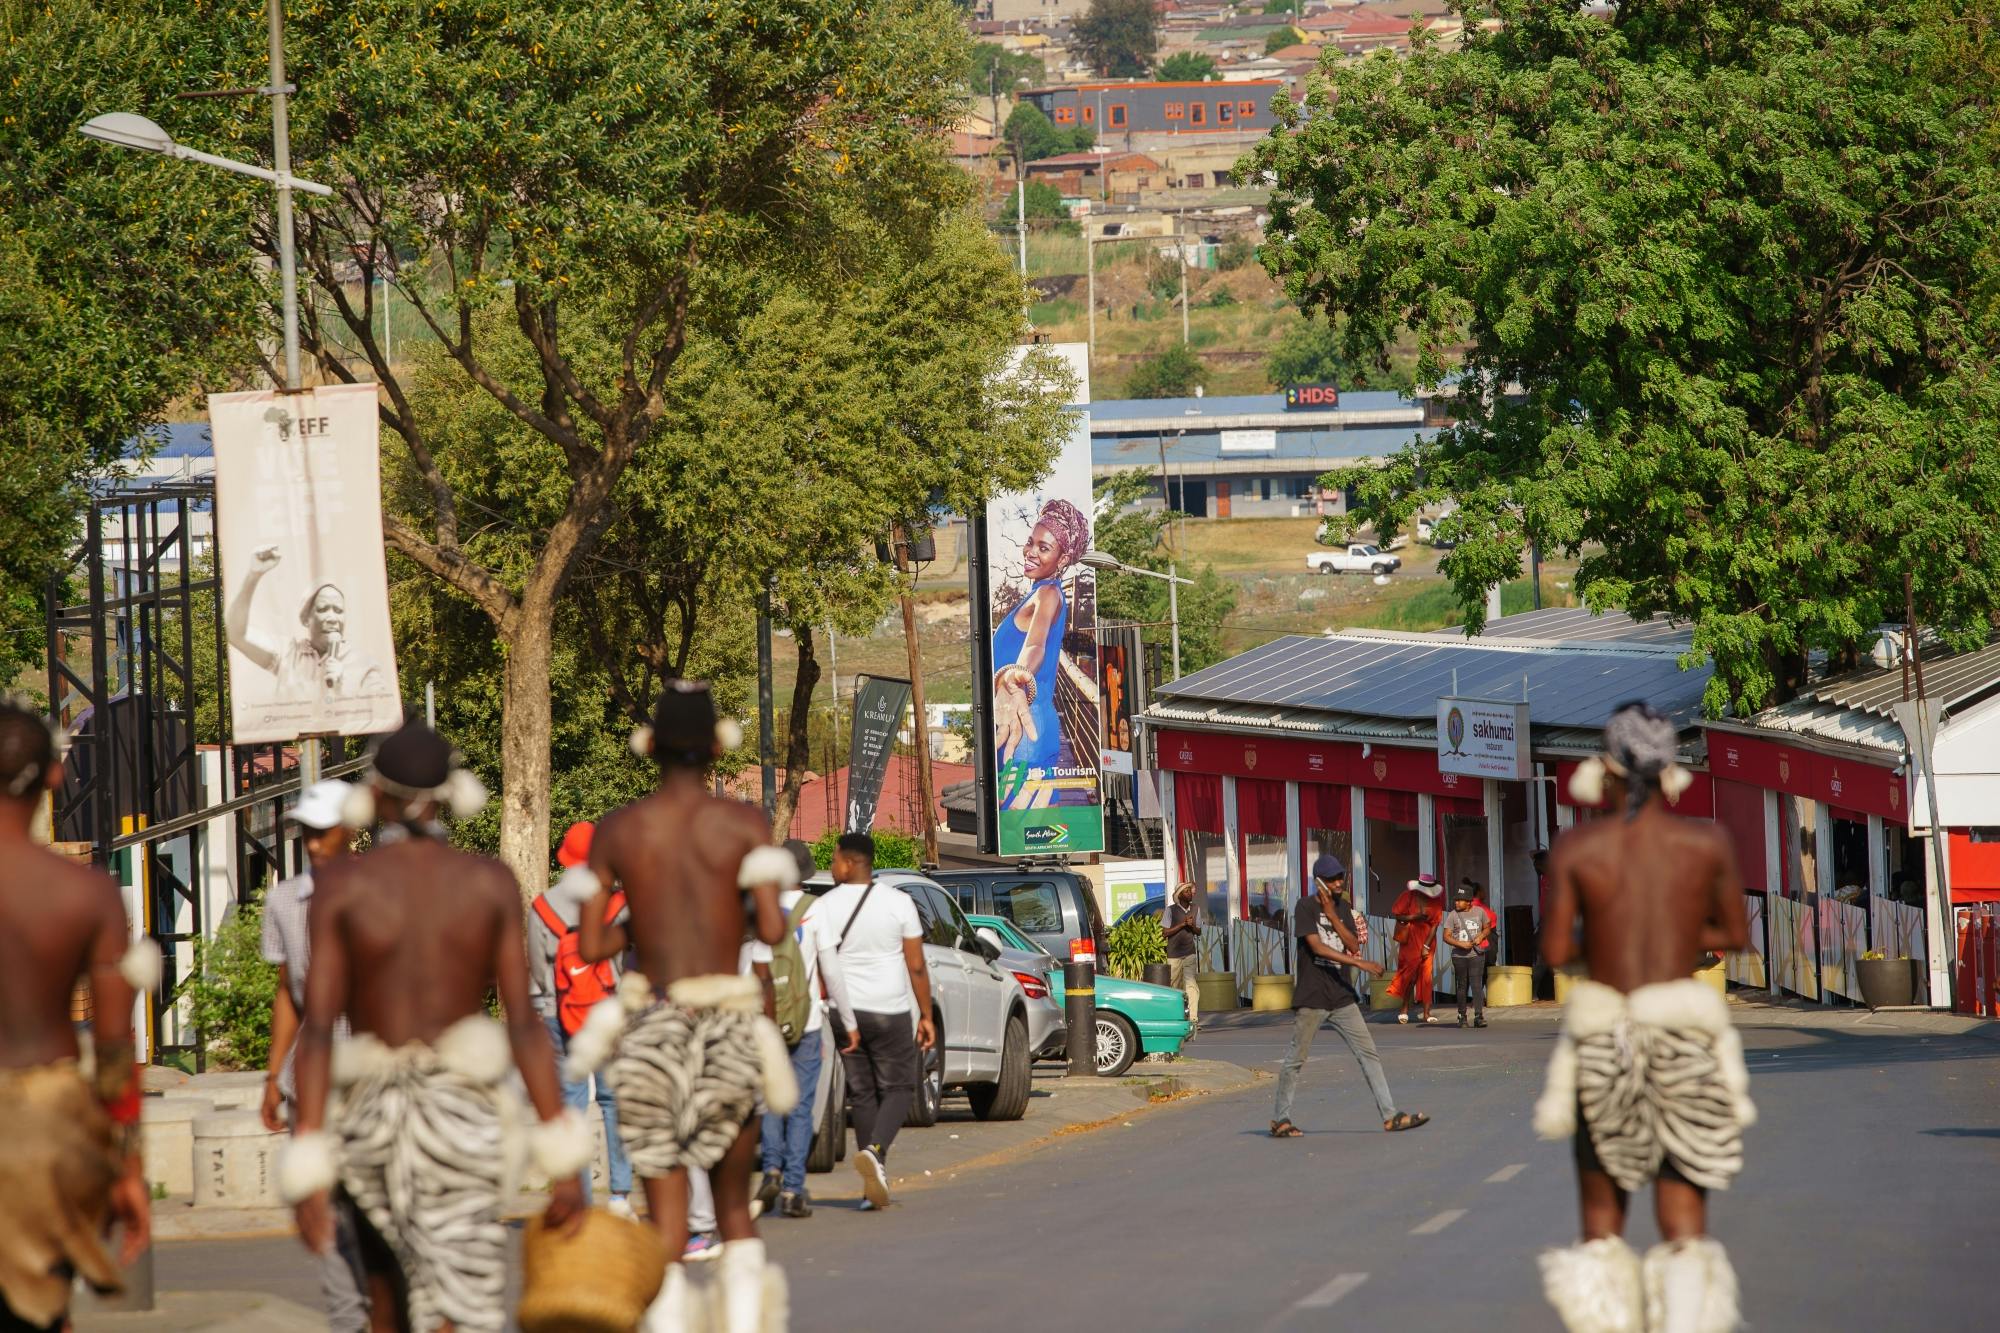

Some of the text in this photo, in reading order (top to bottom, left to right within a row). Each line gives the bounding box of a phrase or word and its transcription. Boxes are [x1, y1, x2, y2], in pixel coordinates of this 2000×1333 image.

[1298, 386, 1337, 405] HDS
[298, 416, 330, 435] EFF
[1473, 719, 1515, 742] sakhumzi
